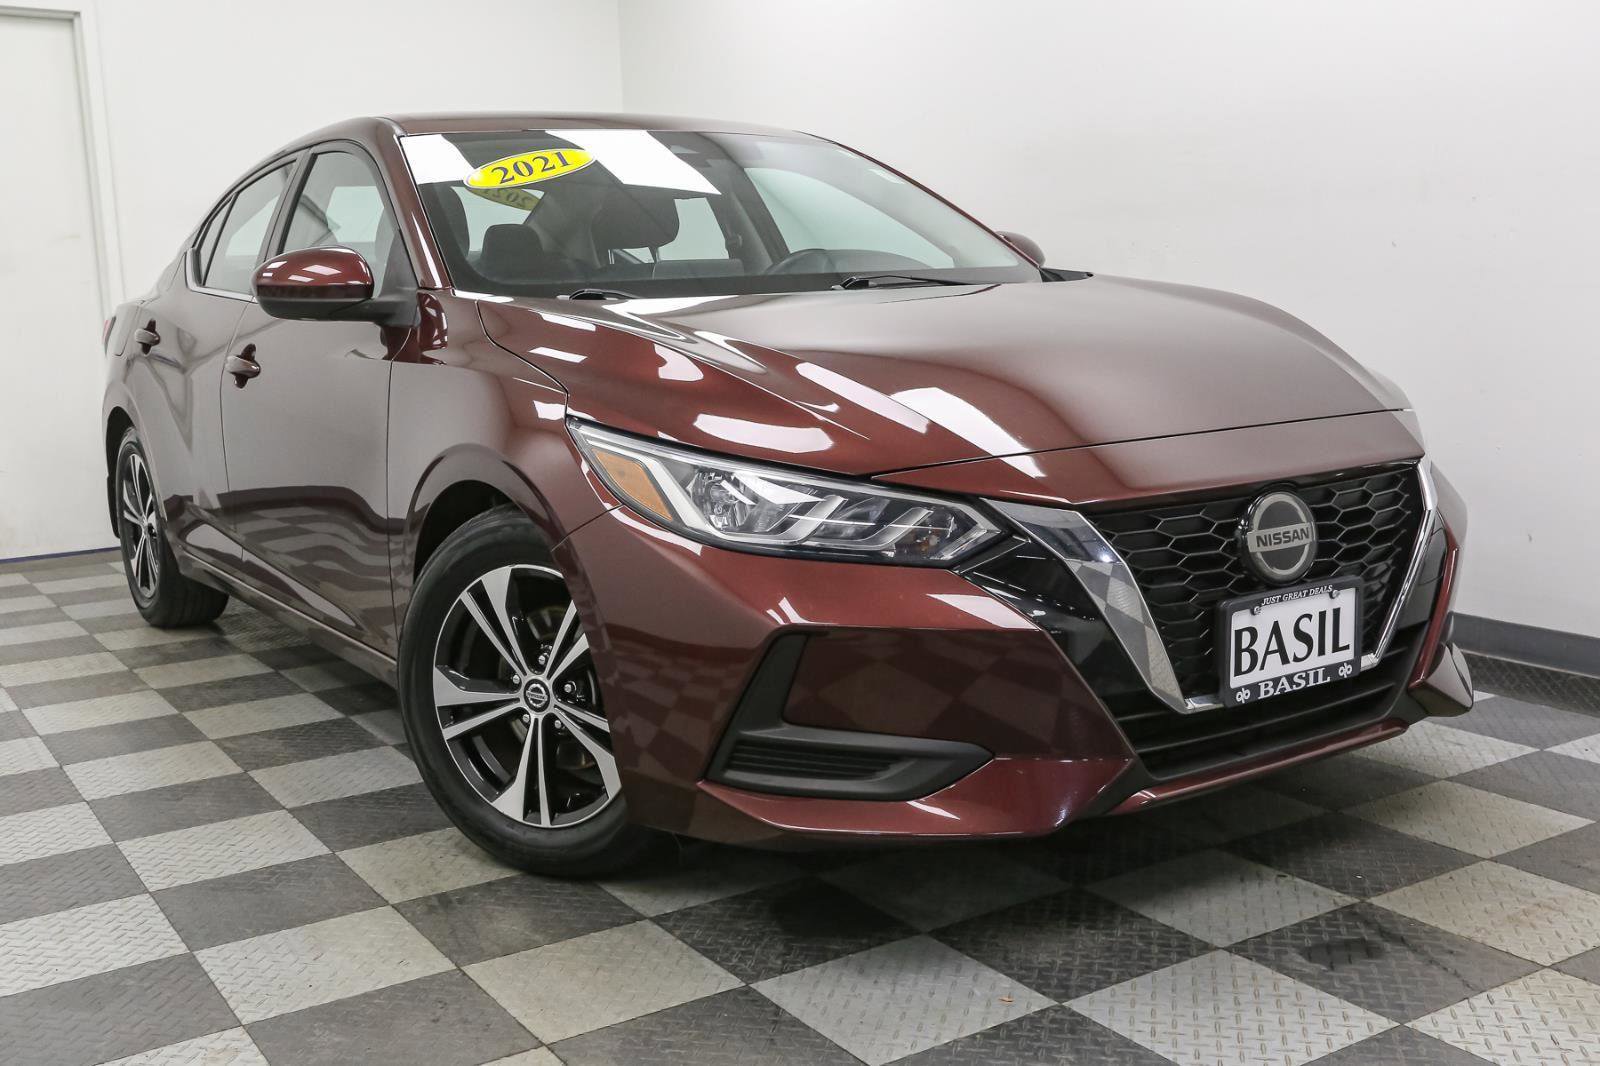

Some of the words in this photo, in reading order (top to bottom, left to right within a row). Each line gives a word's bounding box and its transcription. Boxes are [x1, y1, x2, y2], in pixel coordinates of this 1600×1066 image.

[491, 152, 571, 184] 2021
[1256, 526, 1310, 547] NISSAN
[1262, 595, 1282, 606] JUST
[1282, 590, 1308, 602] GREAT
[1309, 585, 1333, 596] DEALS
[1234, 607, 1350, 677] BASIL
[1258, 668, 1330, 699] BASIL
